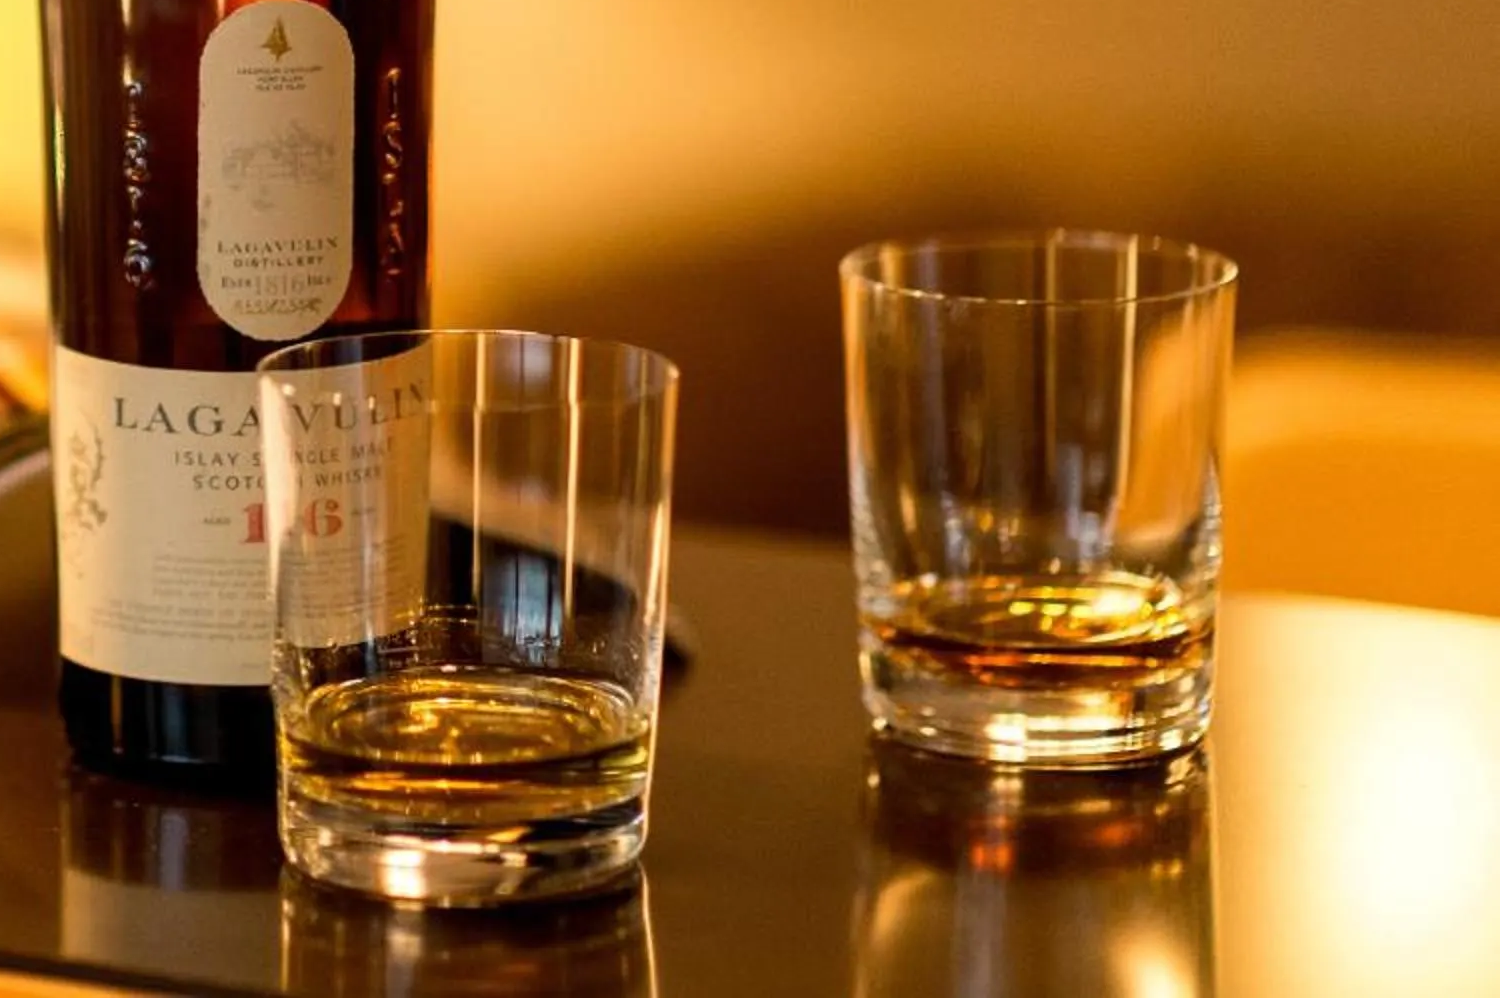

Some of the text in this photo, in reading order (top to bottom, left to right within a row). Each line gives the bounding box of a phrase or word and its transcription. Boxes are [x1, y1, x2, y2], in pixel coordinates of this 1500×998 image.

[233, 255, 324, 268] DISTILLERY
[114, 379, 426, 437] LAGAVULIN
[174, 450, 239, 467] ISLAY
[252, 447, 341, 467] SNGLE
[193, 474, 303, 491] SCOTC
[241, 498, 342, 544] 16
